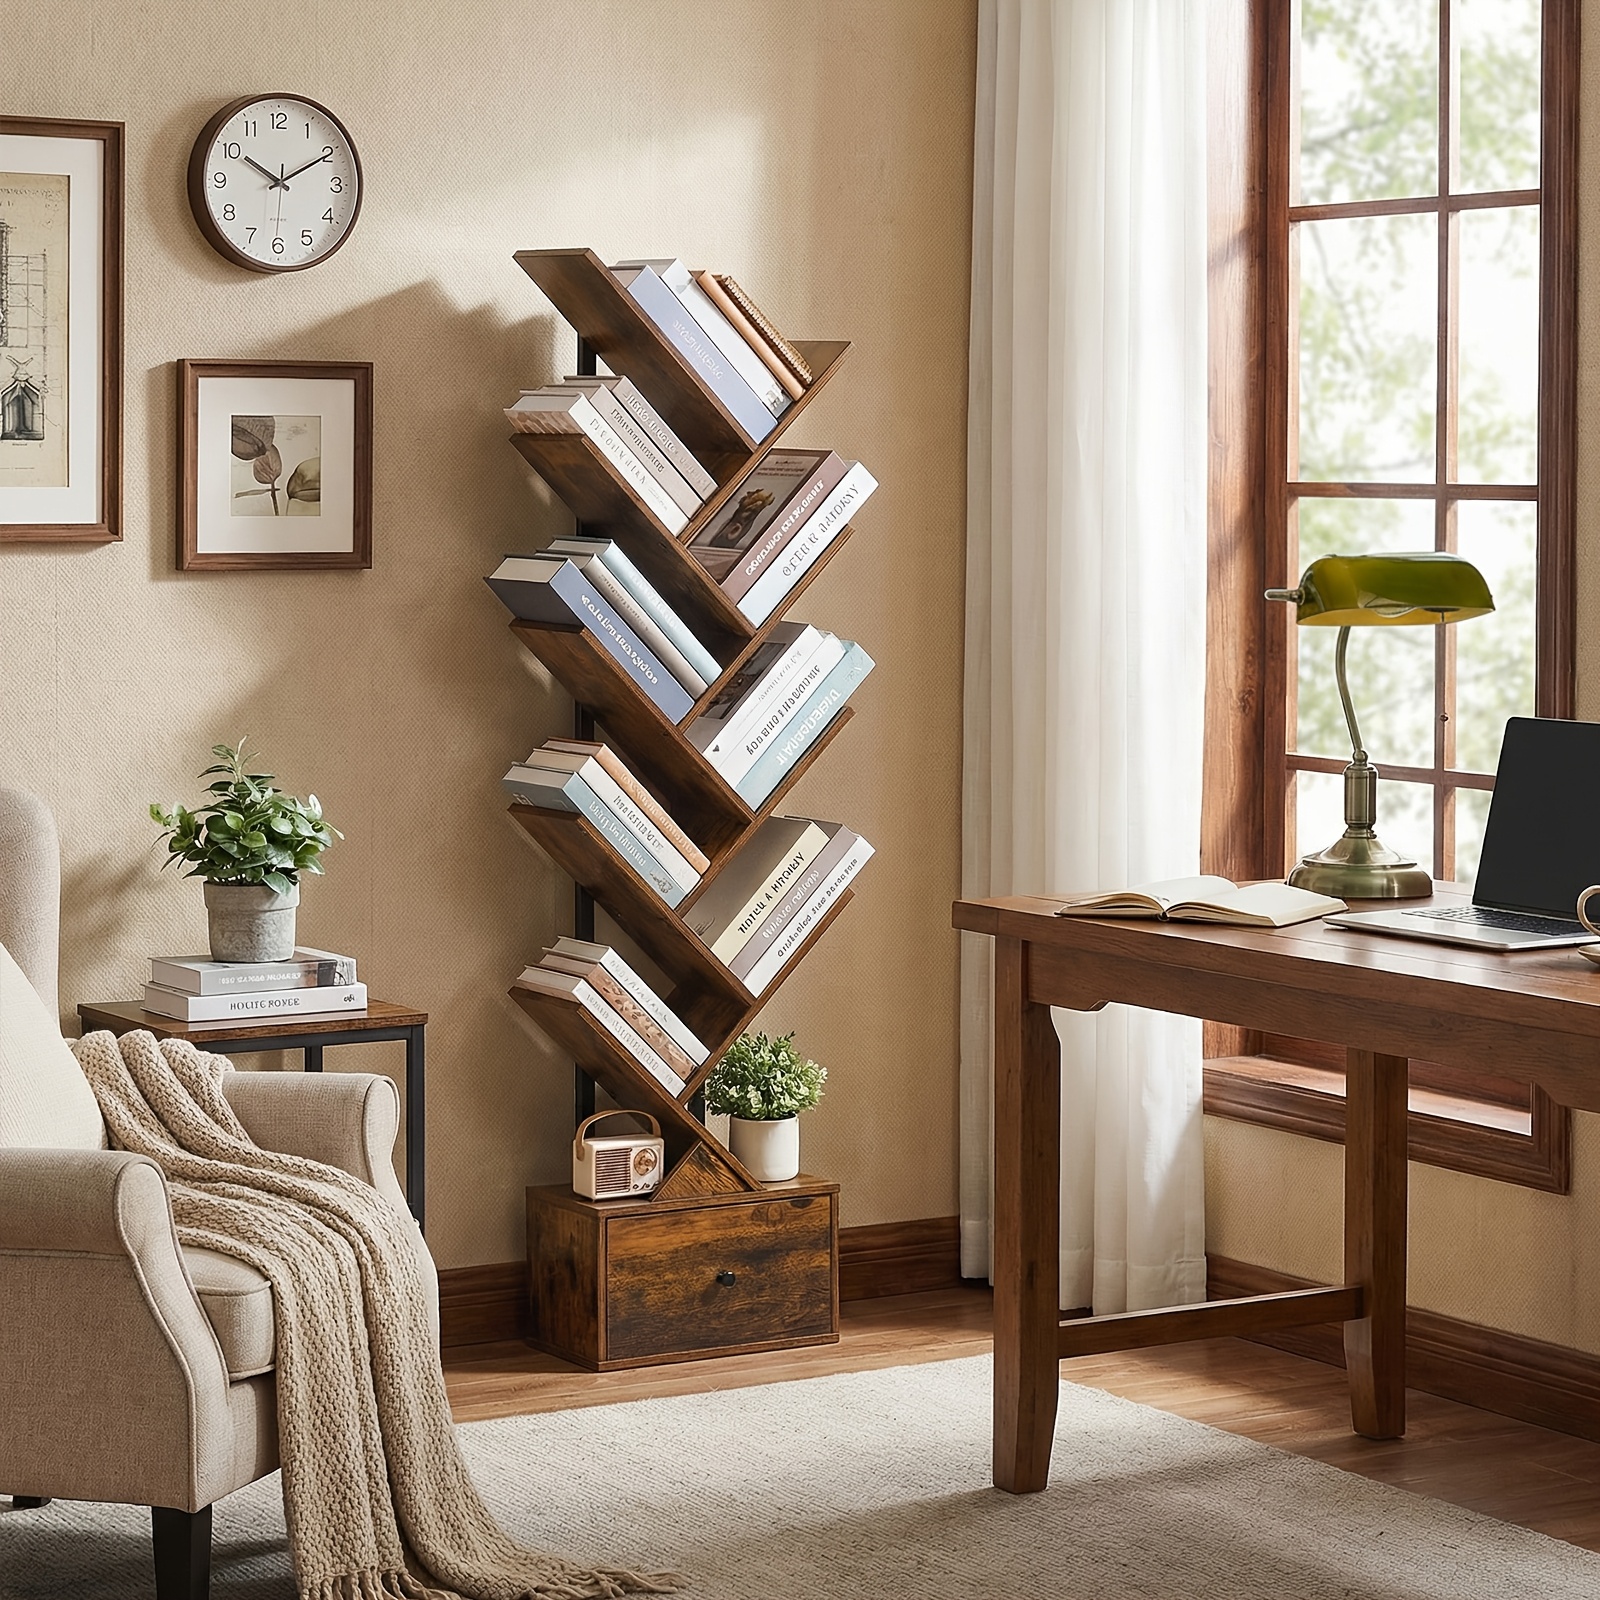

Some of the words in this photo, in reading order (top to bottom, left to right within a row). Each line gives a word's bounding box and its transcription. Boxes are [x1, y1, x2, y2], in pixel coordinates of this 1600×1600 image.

[244, 120, 257, 137] 11
[270, 113, 287, 129] 12
[304, 122, 310, 139] 1
[222, 142, 241, 159] 10
[321, 145, 334, 163] 2
[213, 172, 227, 189] 9
[329, 176, 343, 193] 3
[223, 204, 236, 221] 8
[321, 207, 334, 224] 4
[245, 227, 257, 244] 7
[301, 229, 313, 246] 5
[271, 237, 285, 254] 6
